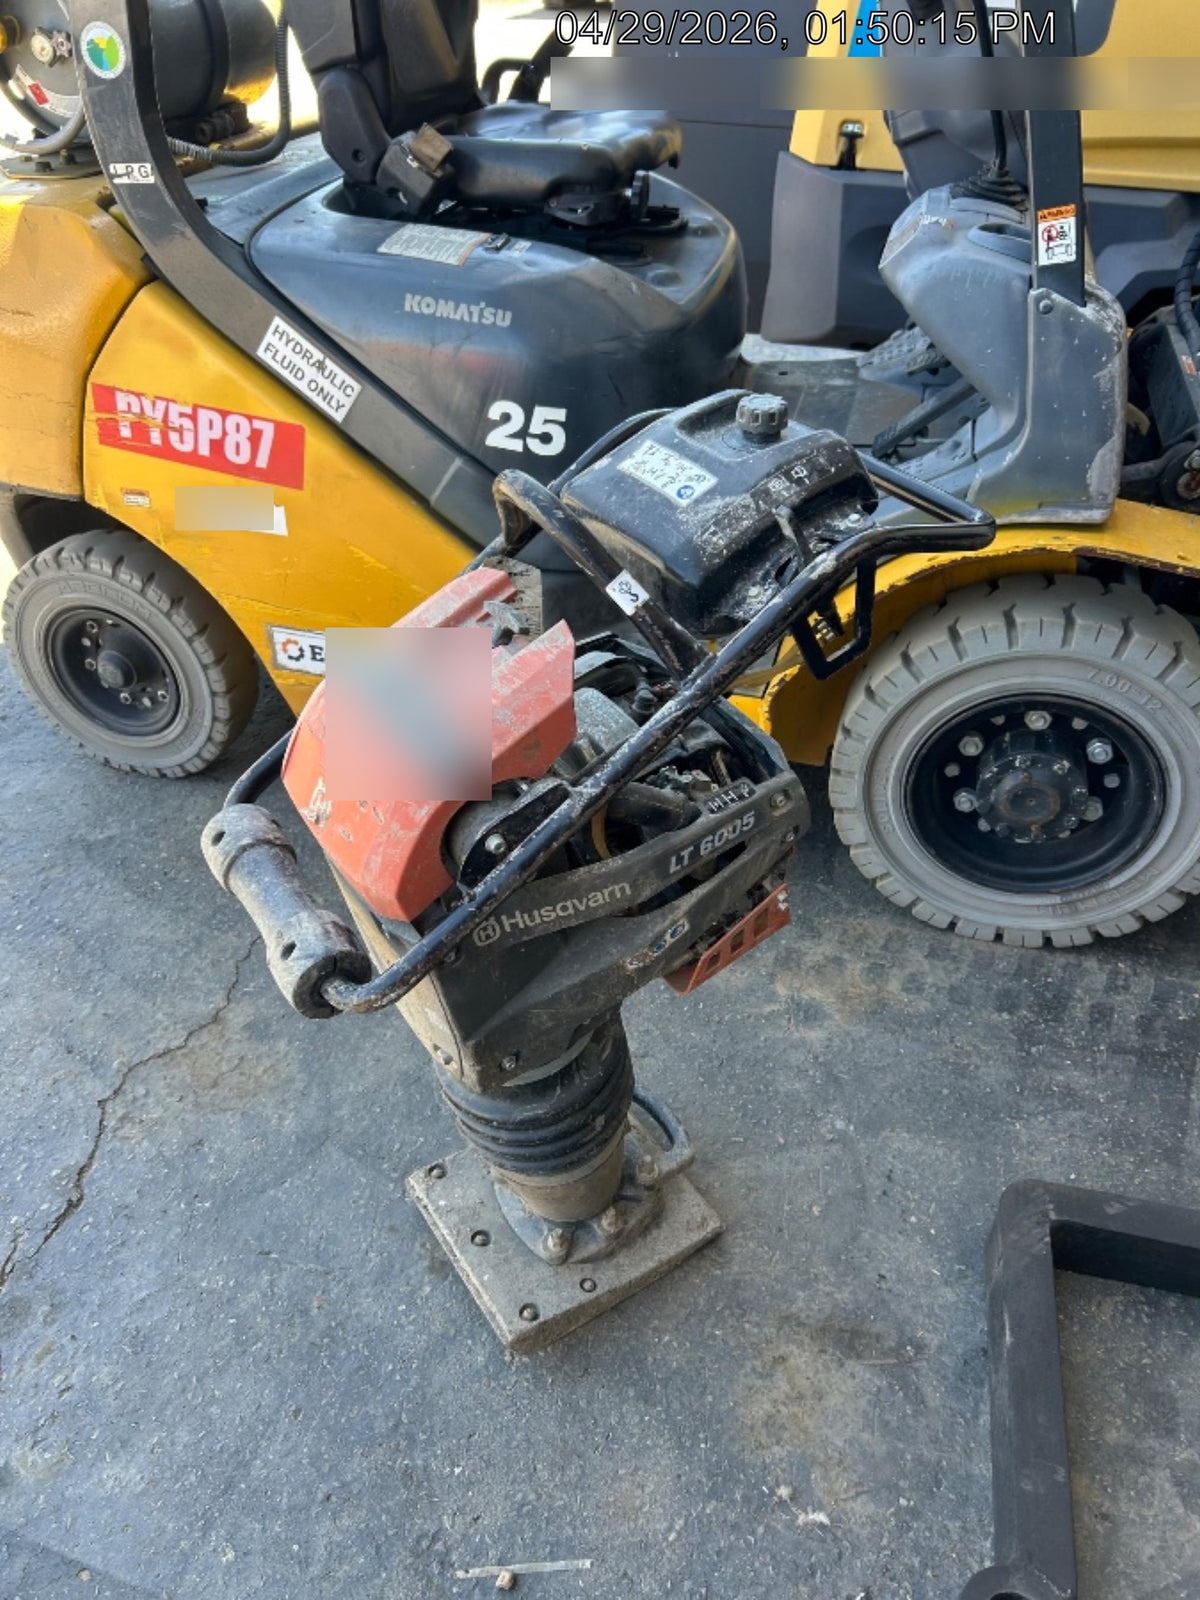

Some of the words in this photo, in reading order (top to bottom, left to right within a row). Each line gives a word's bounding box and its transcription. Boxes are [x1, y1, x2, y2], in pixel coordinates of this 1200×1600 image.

[404, 293, 512, 328] KOMATSU
[263, 342, 306, 381] FLUID
[306, 379, 346, 413] ONLY
[272, 324, 355, 398] HYDRAULIC
[485, 399, 567, 456] 25
[669, 844, 695, 874] LT
